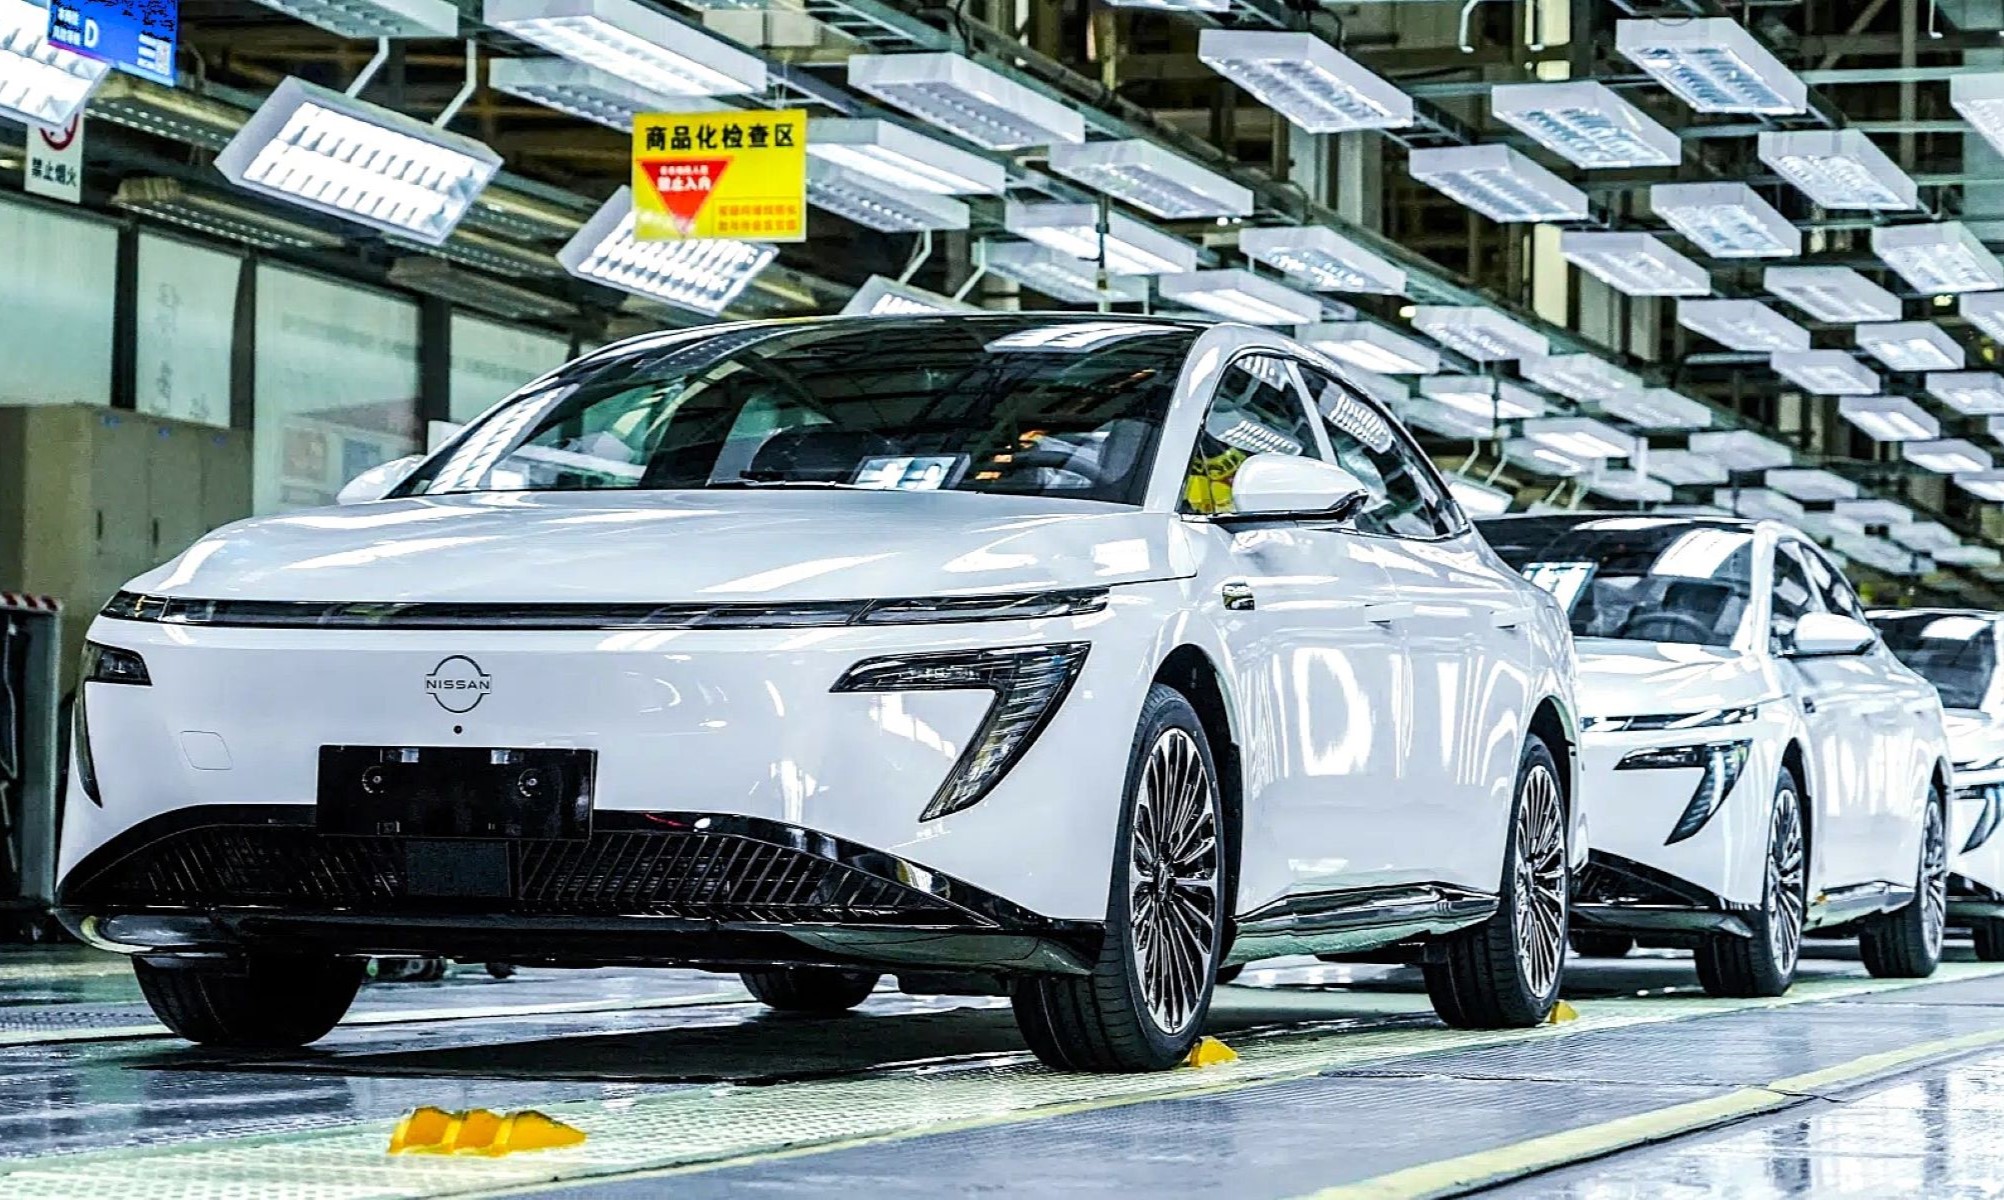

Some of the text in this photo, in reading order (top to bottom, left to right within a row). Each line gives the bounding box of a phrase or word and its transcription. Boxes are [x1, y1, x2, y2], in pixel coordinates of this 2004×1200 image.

[84, 18, 100, 48] D
[645, 122, 795, 151] 商品化检查区
[426, 679, 490, 690] NISSAN
